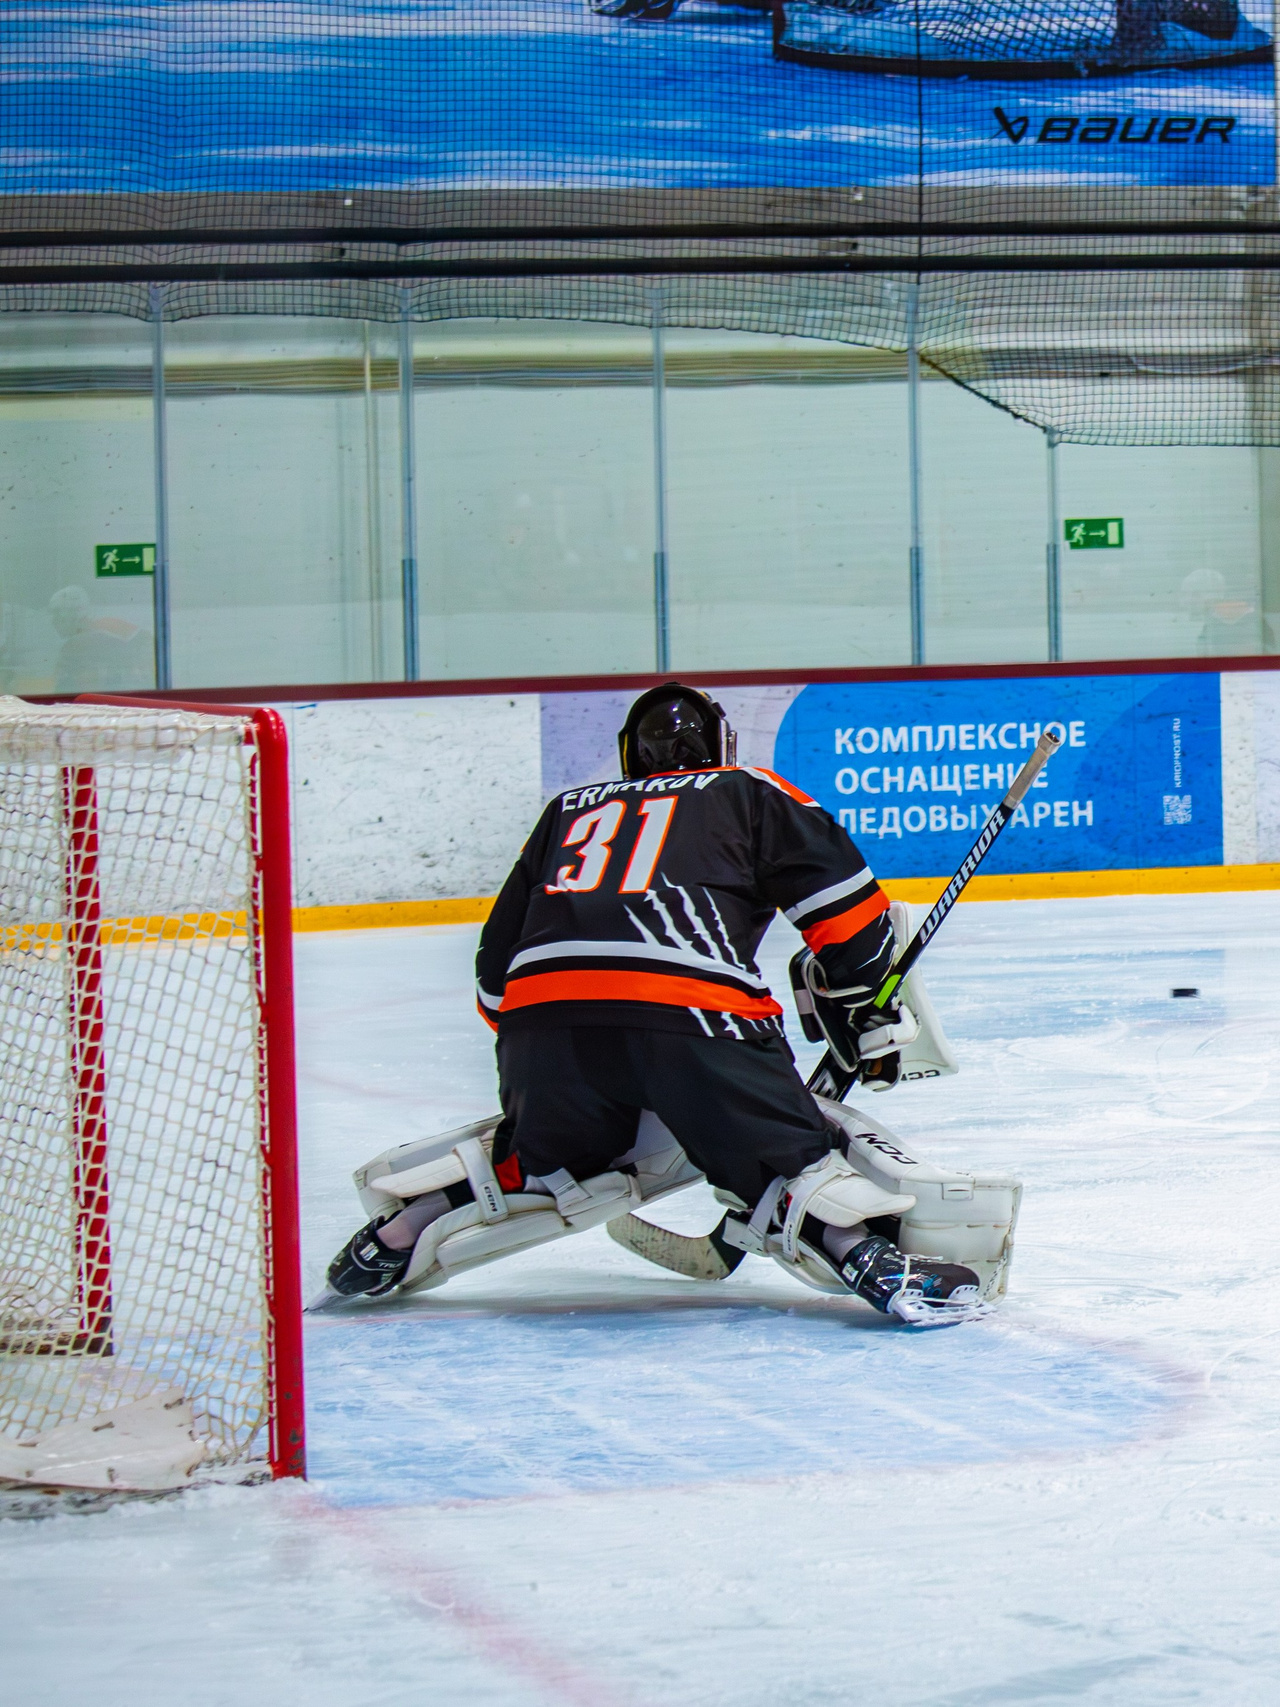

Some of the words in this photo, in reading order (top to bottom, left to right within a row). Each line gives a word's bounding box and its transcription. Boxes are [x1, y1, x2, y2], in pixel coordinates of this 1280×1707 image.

[1037, 117, 1236, 144] BAUER
[834, 720, 1087, 755] КОМПЛЕКСНОЕ
[562, 773, 719, 812] ERMAKOV
[834, 761, 1049, 796] ОСНАЩЕНИЕ
[1009, 800, 1094, 828] АРЕН
[545, 795, 680, 894] 31
[919, 810, 1006, 945] WARRIOR
[855, 1132, 920, 1165] CCM
[483, 1186, 499, 1213] CCM
